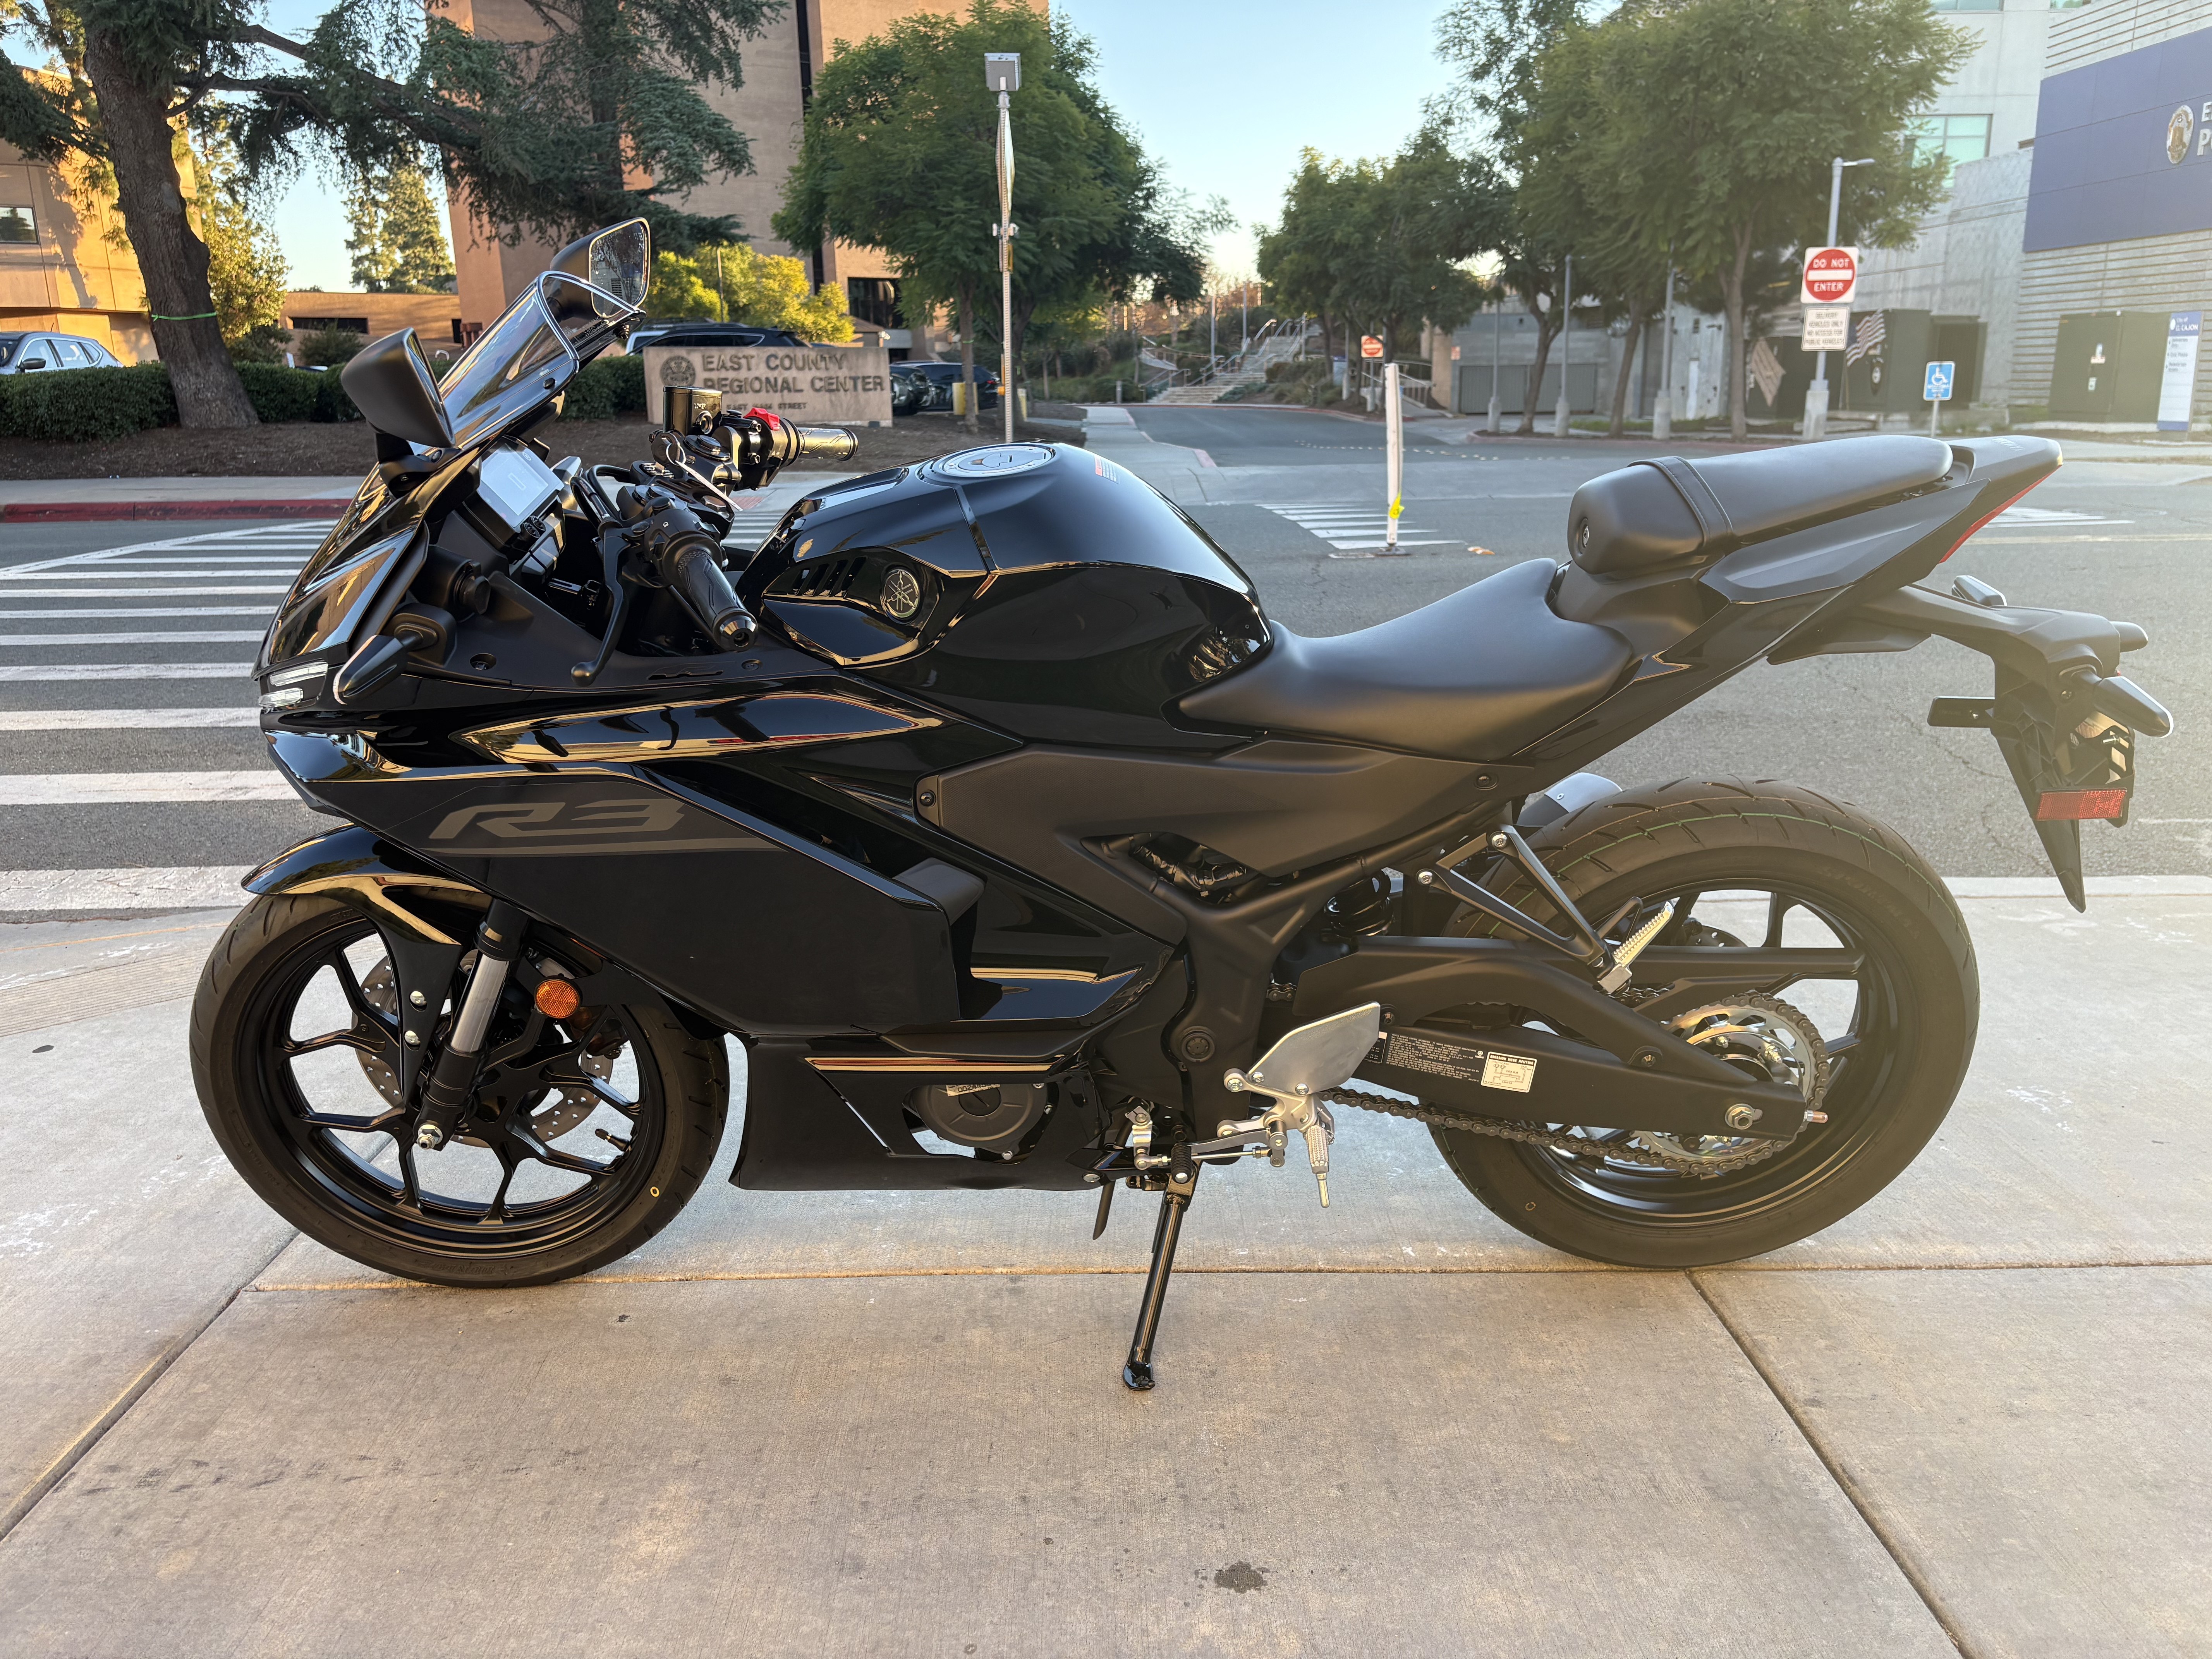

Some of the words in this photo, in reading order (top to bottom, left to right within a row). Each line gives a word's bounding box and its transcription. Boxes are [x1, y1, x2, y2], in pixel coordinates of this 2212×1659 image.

[2197, 129, 2212, 155] P
[1813, 258, 1827, 268] DO
[1831, 258, 1850, 268] NOT
[1814, 282, 1844, 292] ENTER
[702, 354, 755, 371] EAST
[766, 353, 846, 371] COUNTY
[703, 376, 804, 394] REGIONAL
[810, 375, 885, 392] CENTER
[428, 799, 685, 839] R3
